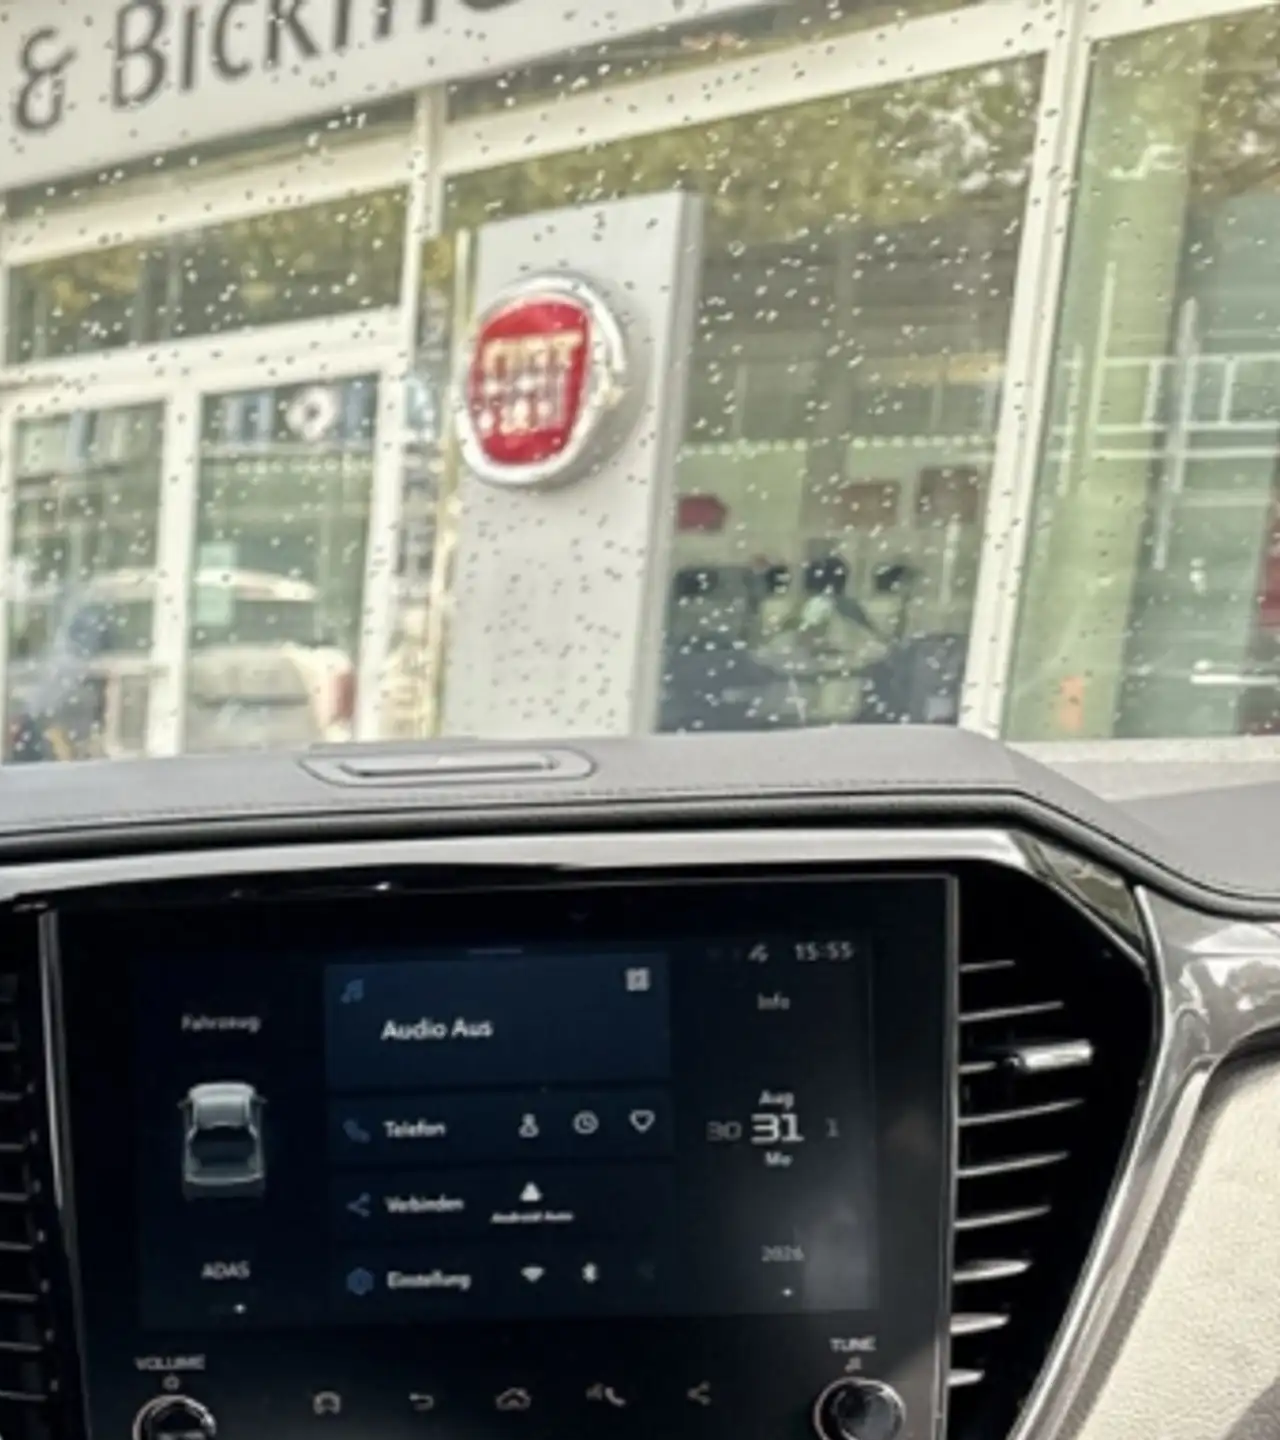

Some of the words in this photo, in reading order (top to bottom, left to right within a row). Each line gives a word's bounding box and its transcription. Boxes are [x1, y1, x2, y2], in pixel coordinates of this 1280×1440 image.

[11, 25, 77, 135] &
[794, 941, 854, 961] 15:55
[756, 993, 790, 1010] Info
[181, 1013, 261, 1034] Fahrzeug
[381, 1017, 447, 1041] Audio
[451, 1016, 493, 1039] Aus
[758, 1089, 794, 1109] Aug
[384, 1119, 446, 1139] Telefon
[751, 1112, 804, 1145] 31
[384, 1194, 465, 1214] Verbinden
[201, 1261, 251, 1280] ADAS
[134, 1354, 206, 1371] VOLUME
